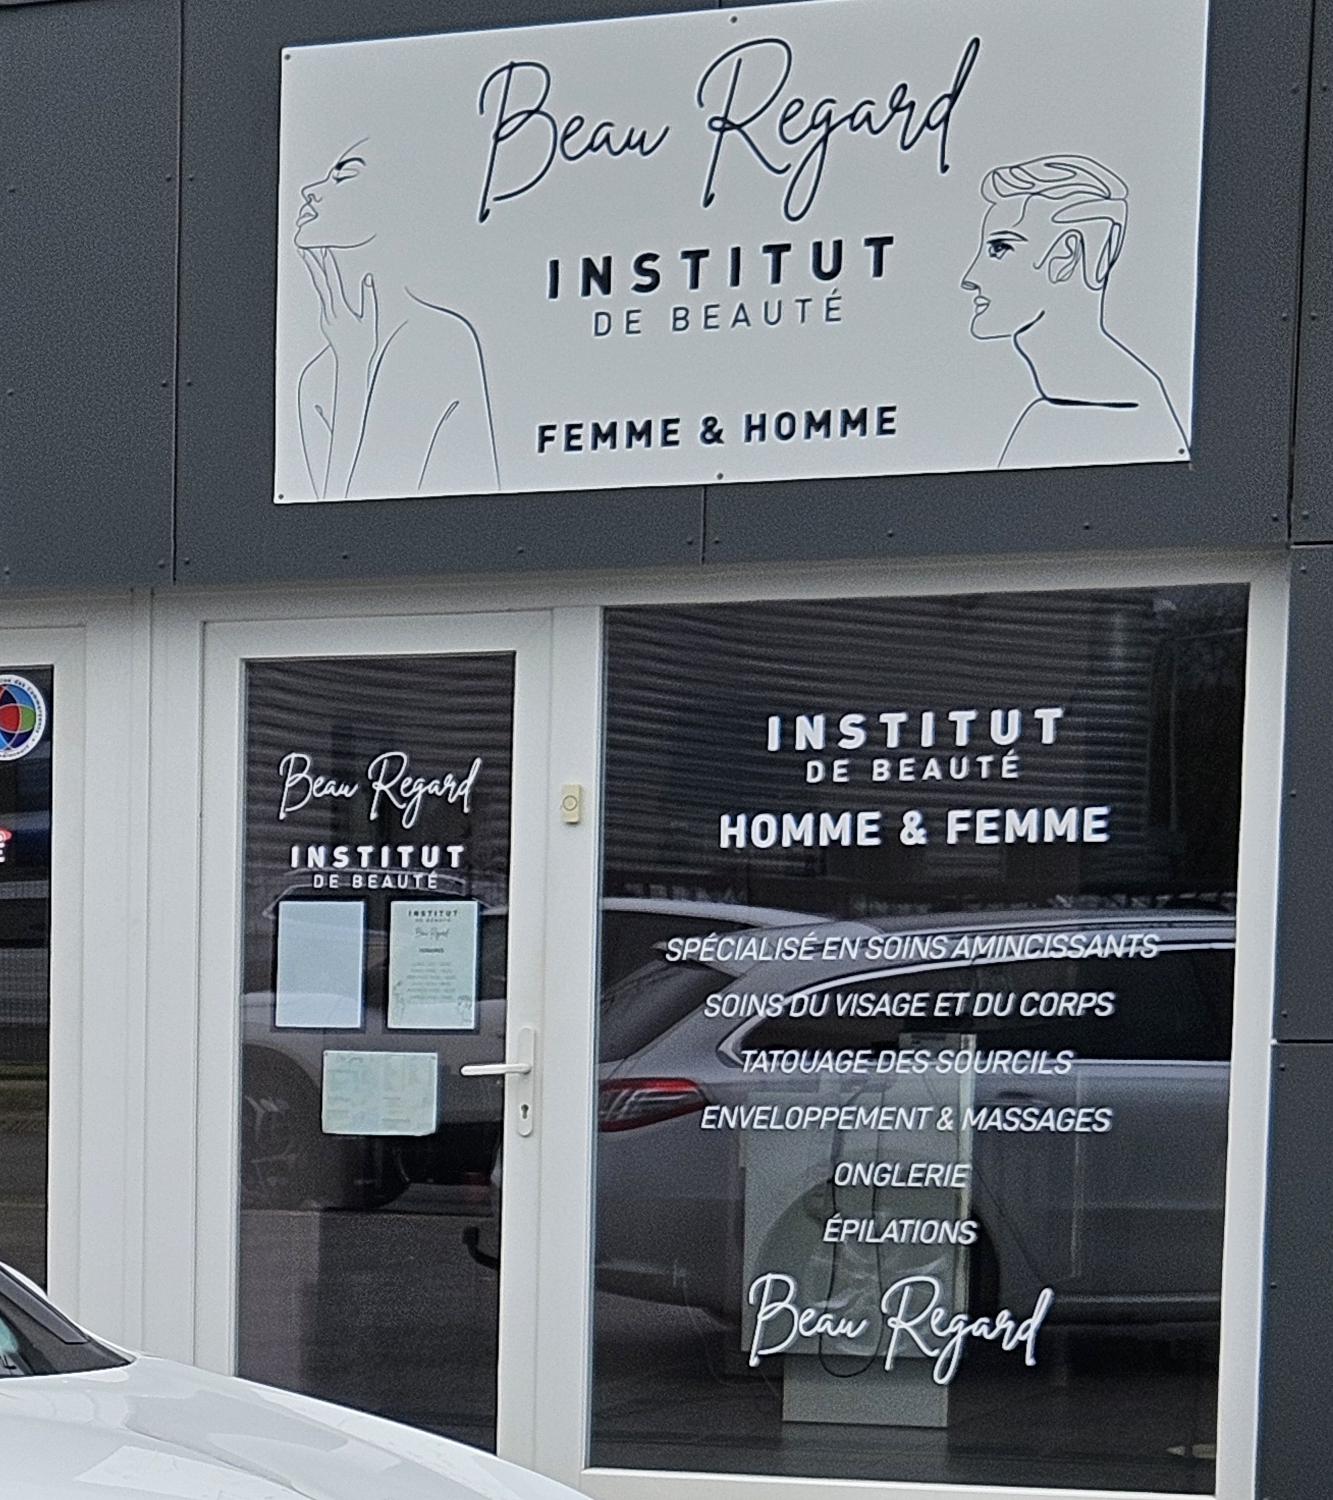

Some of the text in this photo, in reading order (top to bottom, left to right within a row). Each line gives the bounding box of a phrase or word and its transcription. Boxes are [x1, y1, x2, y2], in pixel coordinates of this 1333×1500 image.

[477, 36, 980, 224] Beau Regard
[547, 235, 895, 300] INSTITUT
[592, 290, 844, 338] DE BEAUTÉ
[536, 405, 899, 455] FEMME & HOMME
[767, 707, 1064, 752] INSTITUT
[806, 749, 1020, 783] DE BEAUTÉ
[278, 751, 483, 829] Beau Regard
[719, 805, 1111, 848] HOMME & FEMME
[290, 844, 465, 869] INSTITUT
[313, 871, 438, 889] DE BEAUTÉ
[665, 931, 1160, 962] SPÉCIALISÉ EN SOINS AMINCISSANTS
[704, 992, 1116, 1017] SOINS DU VISAGE ET DU CORPS
[741, 1049, 1074, 1074] TATOUAGE DES SOURCILS
[700, 1105, 1112, 1132] ENVELOPPEMENT & MASSAGES
[834, 1162, 972, 1188] ONGLERIE
[823, 1213, 978, 1245] ÉPILATIONS
[748, 1273, 1054, 1385] Beau Regard
